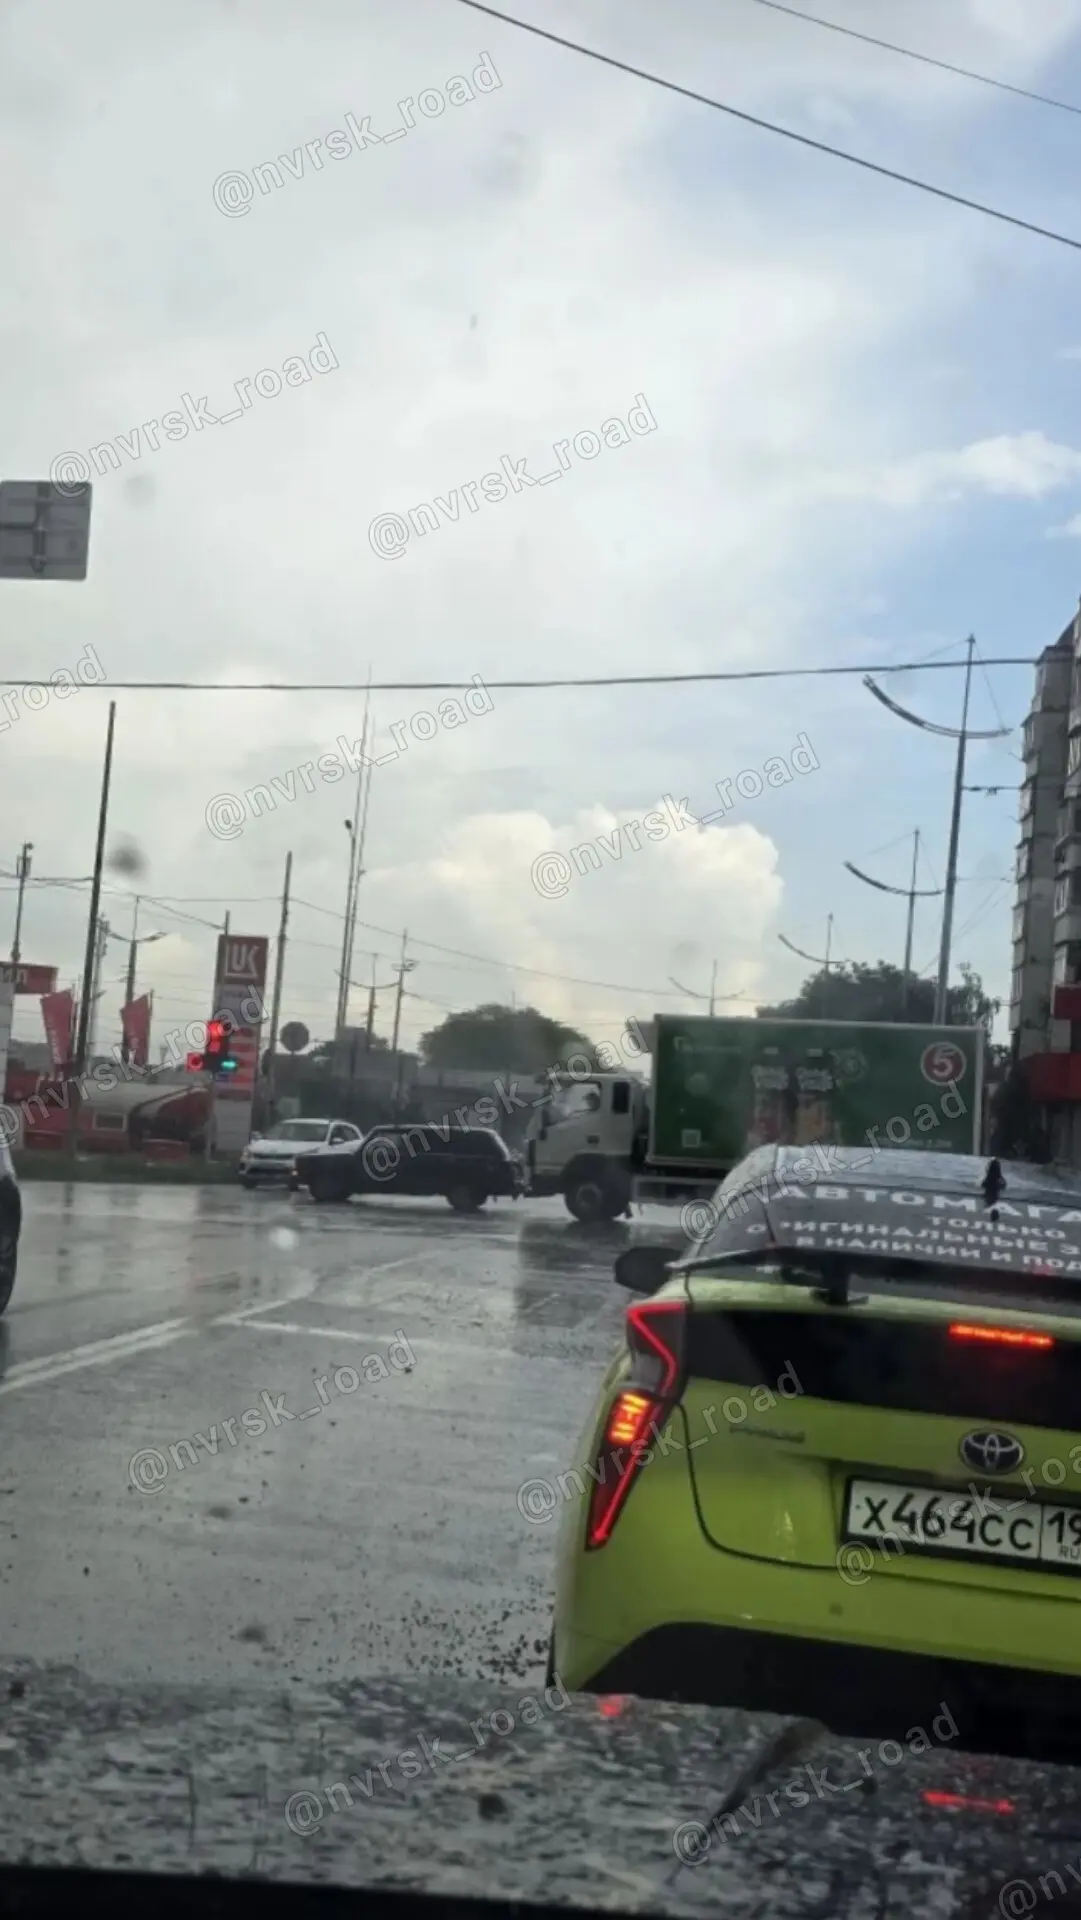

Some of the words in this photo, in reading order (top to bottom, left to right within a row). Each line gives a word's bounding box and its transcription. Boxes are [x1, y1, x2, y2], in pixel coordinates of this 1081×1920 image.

[932, 1051, 954, 1077] 5
[926, 1216, 1066, 1239] ТОЛЬКО
[825, 1237, 981, 1260] НАЛИЧИИ
[990, 1250, 1013, 1263] И
